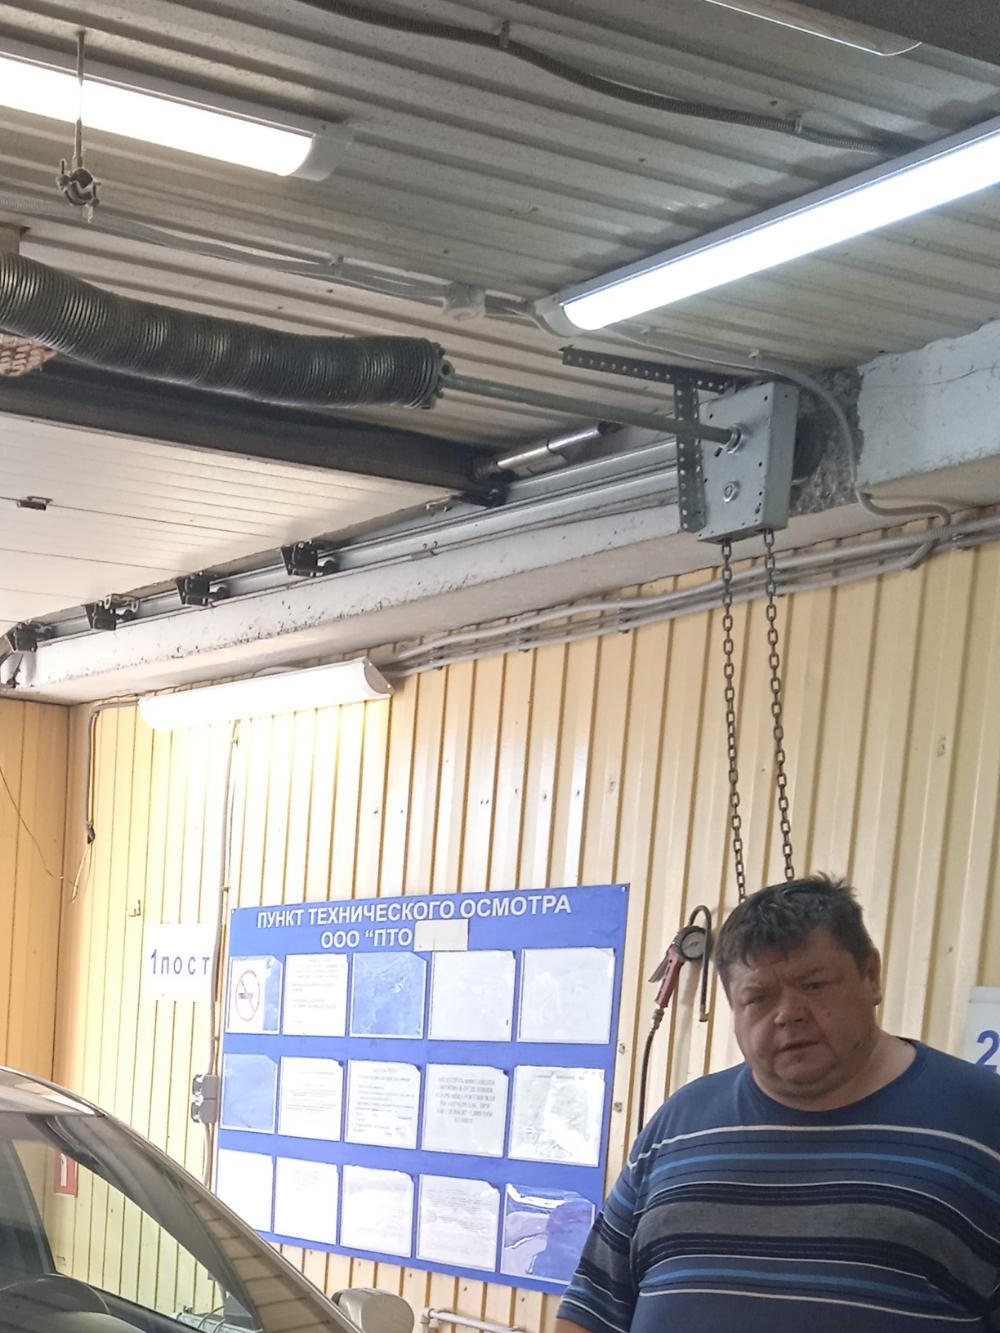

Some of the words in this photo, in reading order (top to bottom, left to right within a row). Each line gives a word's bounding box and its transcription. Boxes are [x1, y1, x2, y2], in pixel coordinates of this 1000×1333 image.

[257, 909, 304, 929] ПУНКТ
[308, 900, 458, 926] ТЕХНИЧЕСКОГО
[460, 894, 573, 919] ОСМОТРА
[320, 930, 360, 949] ООО
